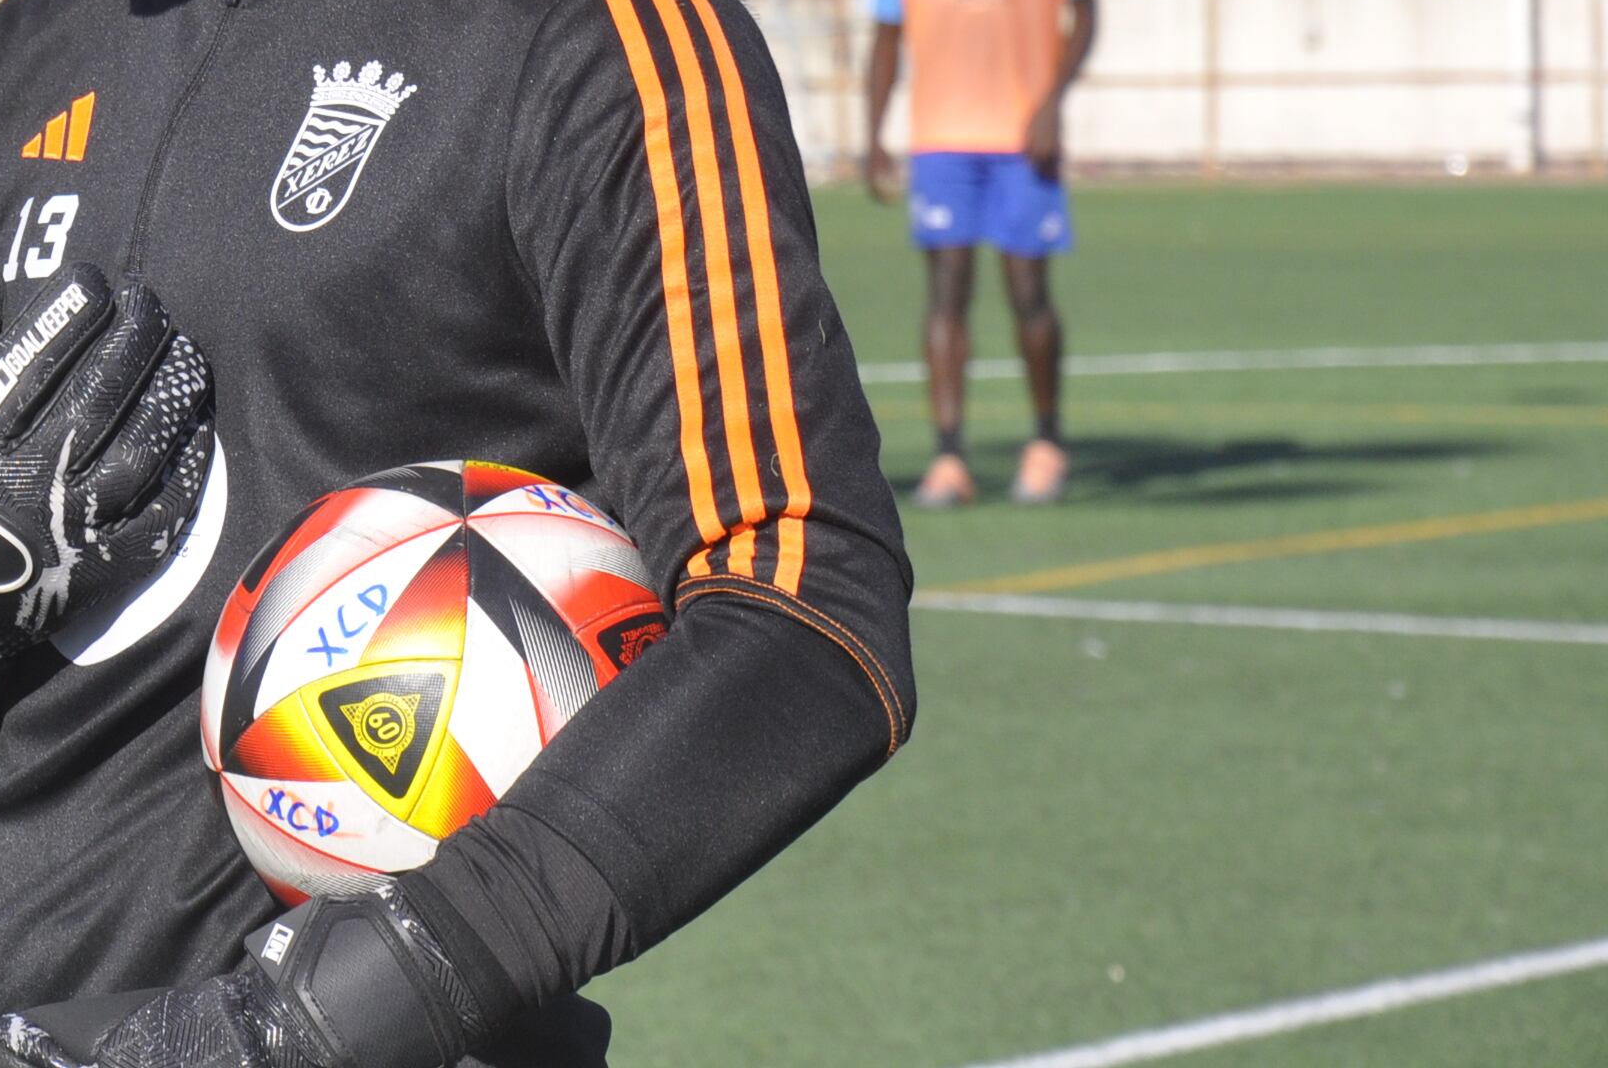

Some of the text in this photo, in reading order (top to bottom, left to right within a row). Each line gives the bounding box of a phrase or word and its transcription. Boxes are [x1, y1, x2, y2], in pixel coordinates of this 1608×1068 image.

[284, 127, 374, 198] XEREZ
[2, 194, 80, 283] 13
[306, 583, 388, 667] XCD
[367, 712, 401, 740] 60
[264, 787, 340, 837] XCD
